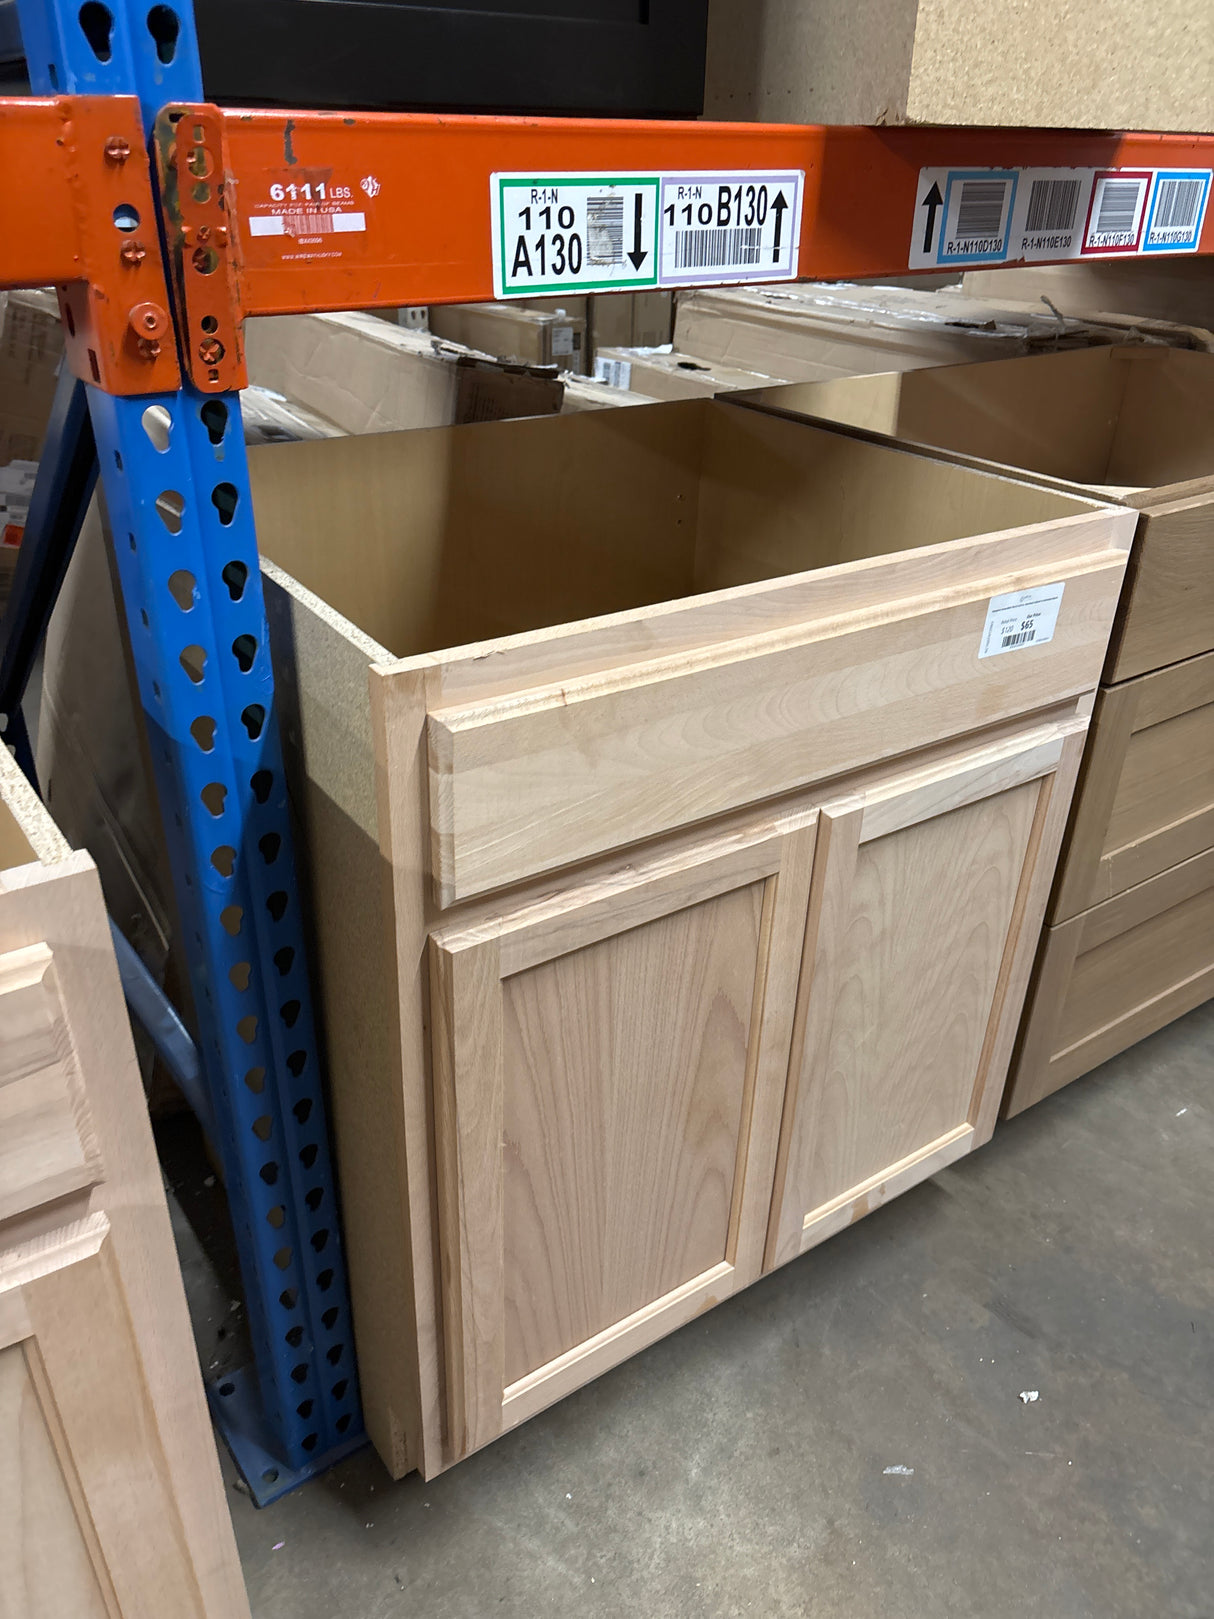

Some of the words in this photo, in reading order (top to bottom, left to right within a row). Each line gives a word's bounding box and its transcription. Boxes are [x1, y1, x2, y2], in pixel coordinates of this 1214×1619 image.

[270, 182, 326, 201] 6111
[531, 188, 558, 204] R-1-N
[677, 185, 702, 200] R-1-N
[271, 207, 303, 216] MADE
[320, 206, 343, 214] USA
[518, 205, 575, 231] 110
[1021, 236, 1073, 250] R-1-N110E130
[1089, 232, 1136, 247] R-1-N110F130
[1148, 230, 1193, 245] R-1-N110G130
[946, 238, 1003, 255] R-1-N110D130
[511, 232, 583, 278] A130
[1021, 619, 1034, 631] $65
